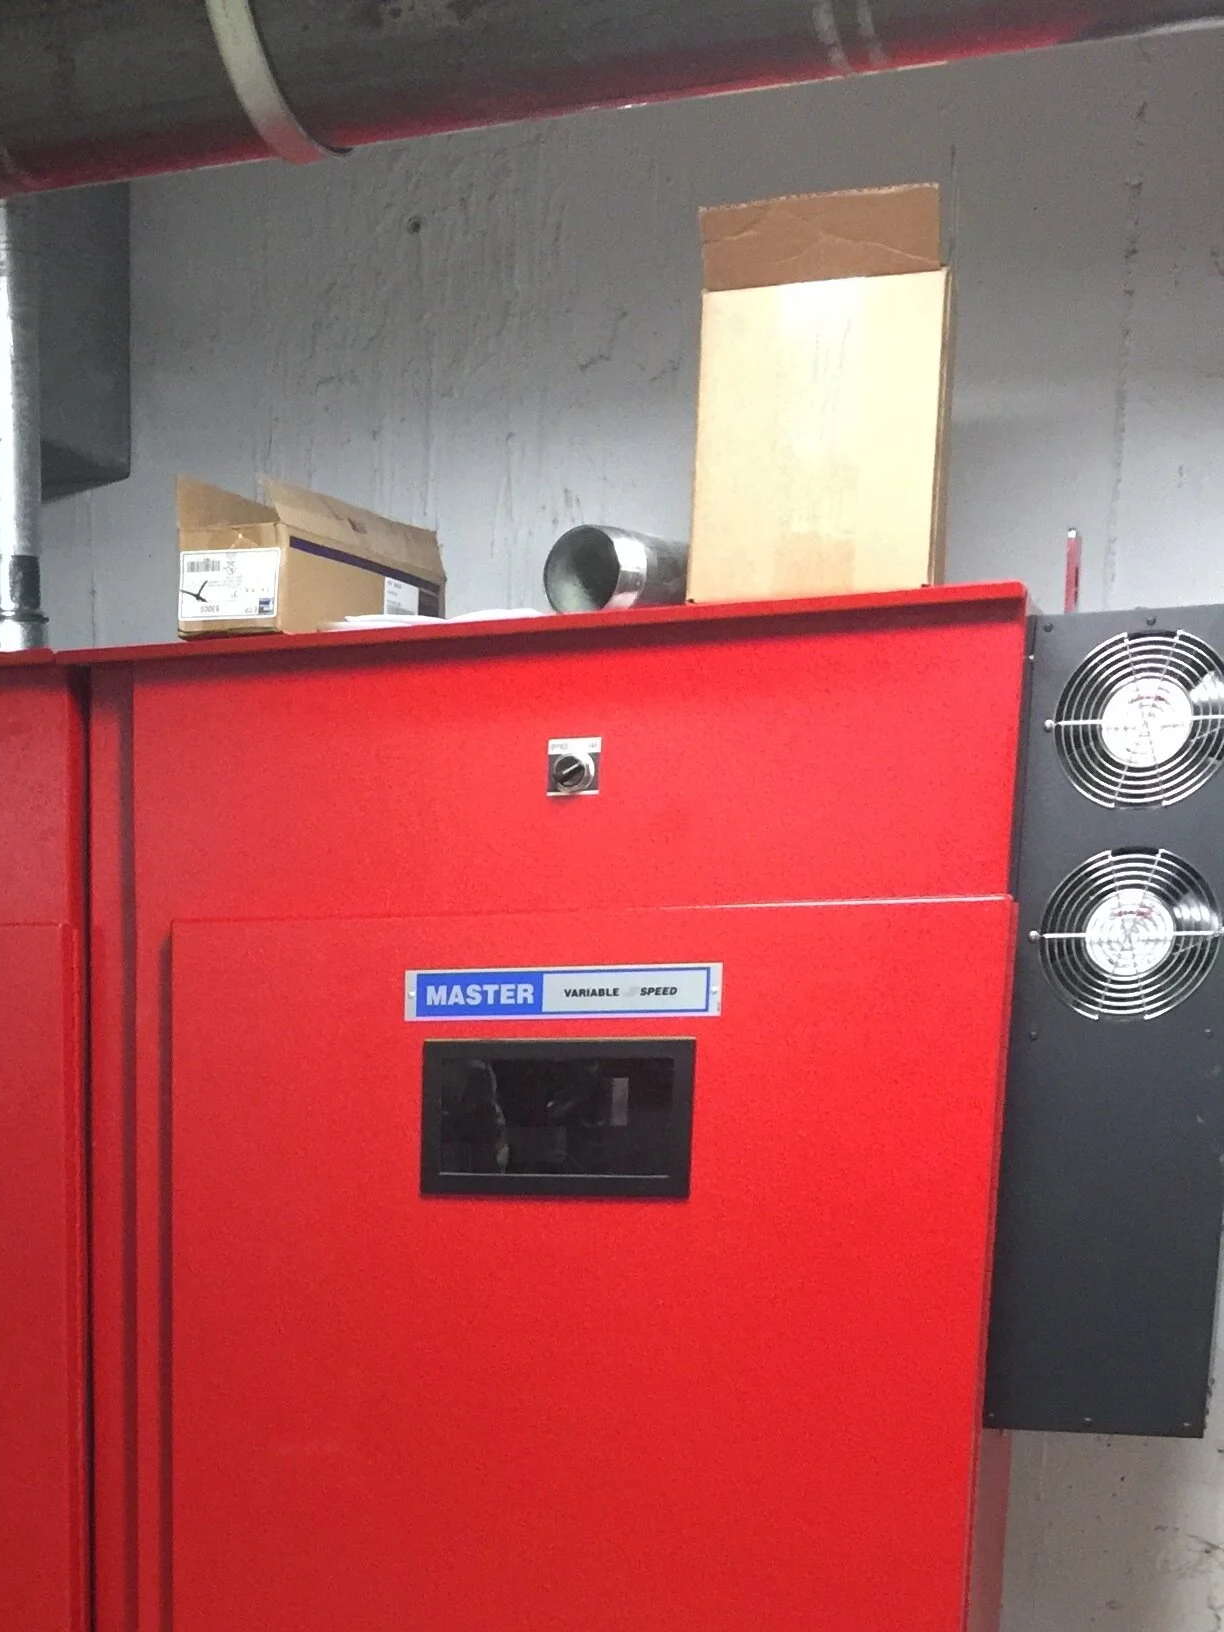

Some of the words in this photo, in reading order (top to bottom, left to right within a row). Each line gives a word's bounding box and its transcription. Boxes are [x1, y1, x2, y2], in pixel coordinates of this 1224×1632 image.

[426, 983, 534, 1006] MASTER
[564, 988, 619, 998] VARIABLE
[640, 986, 678, 996] SPEED
